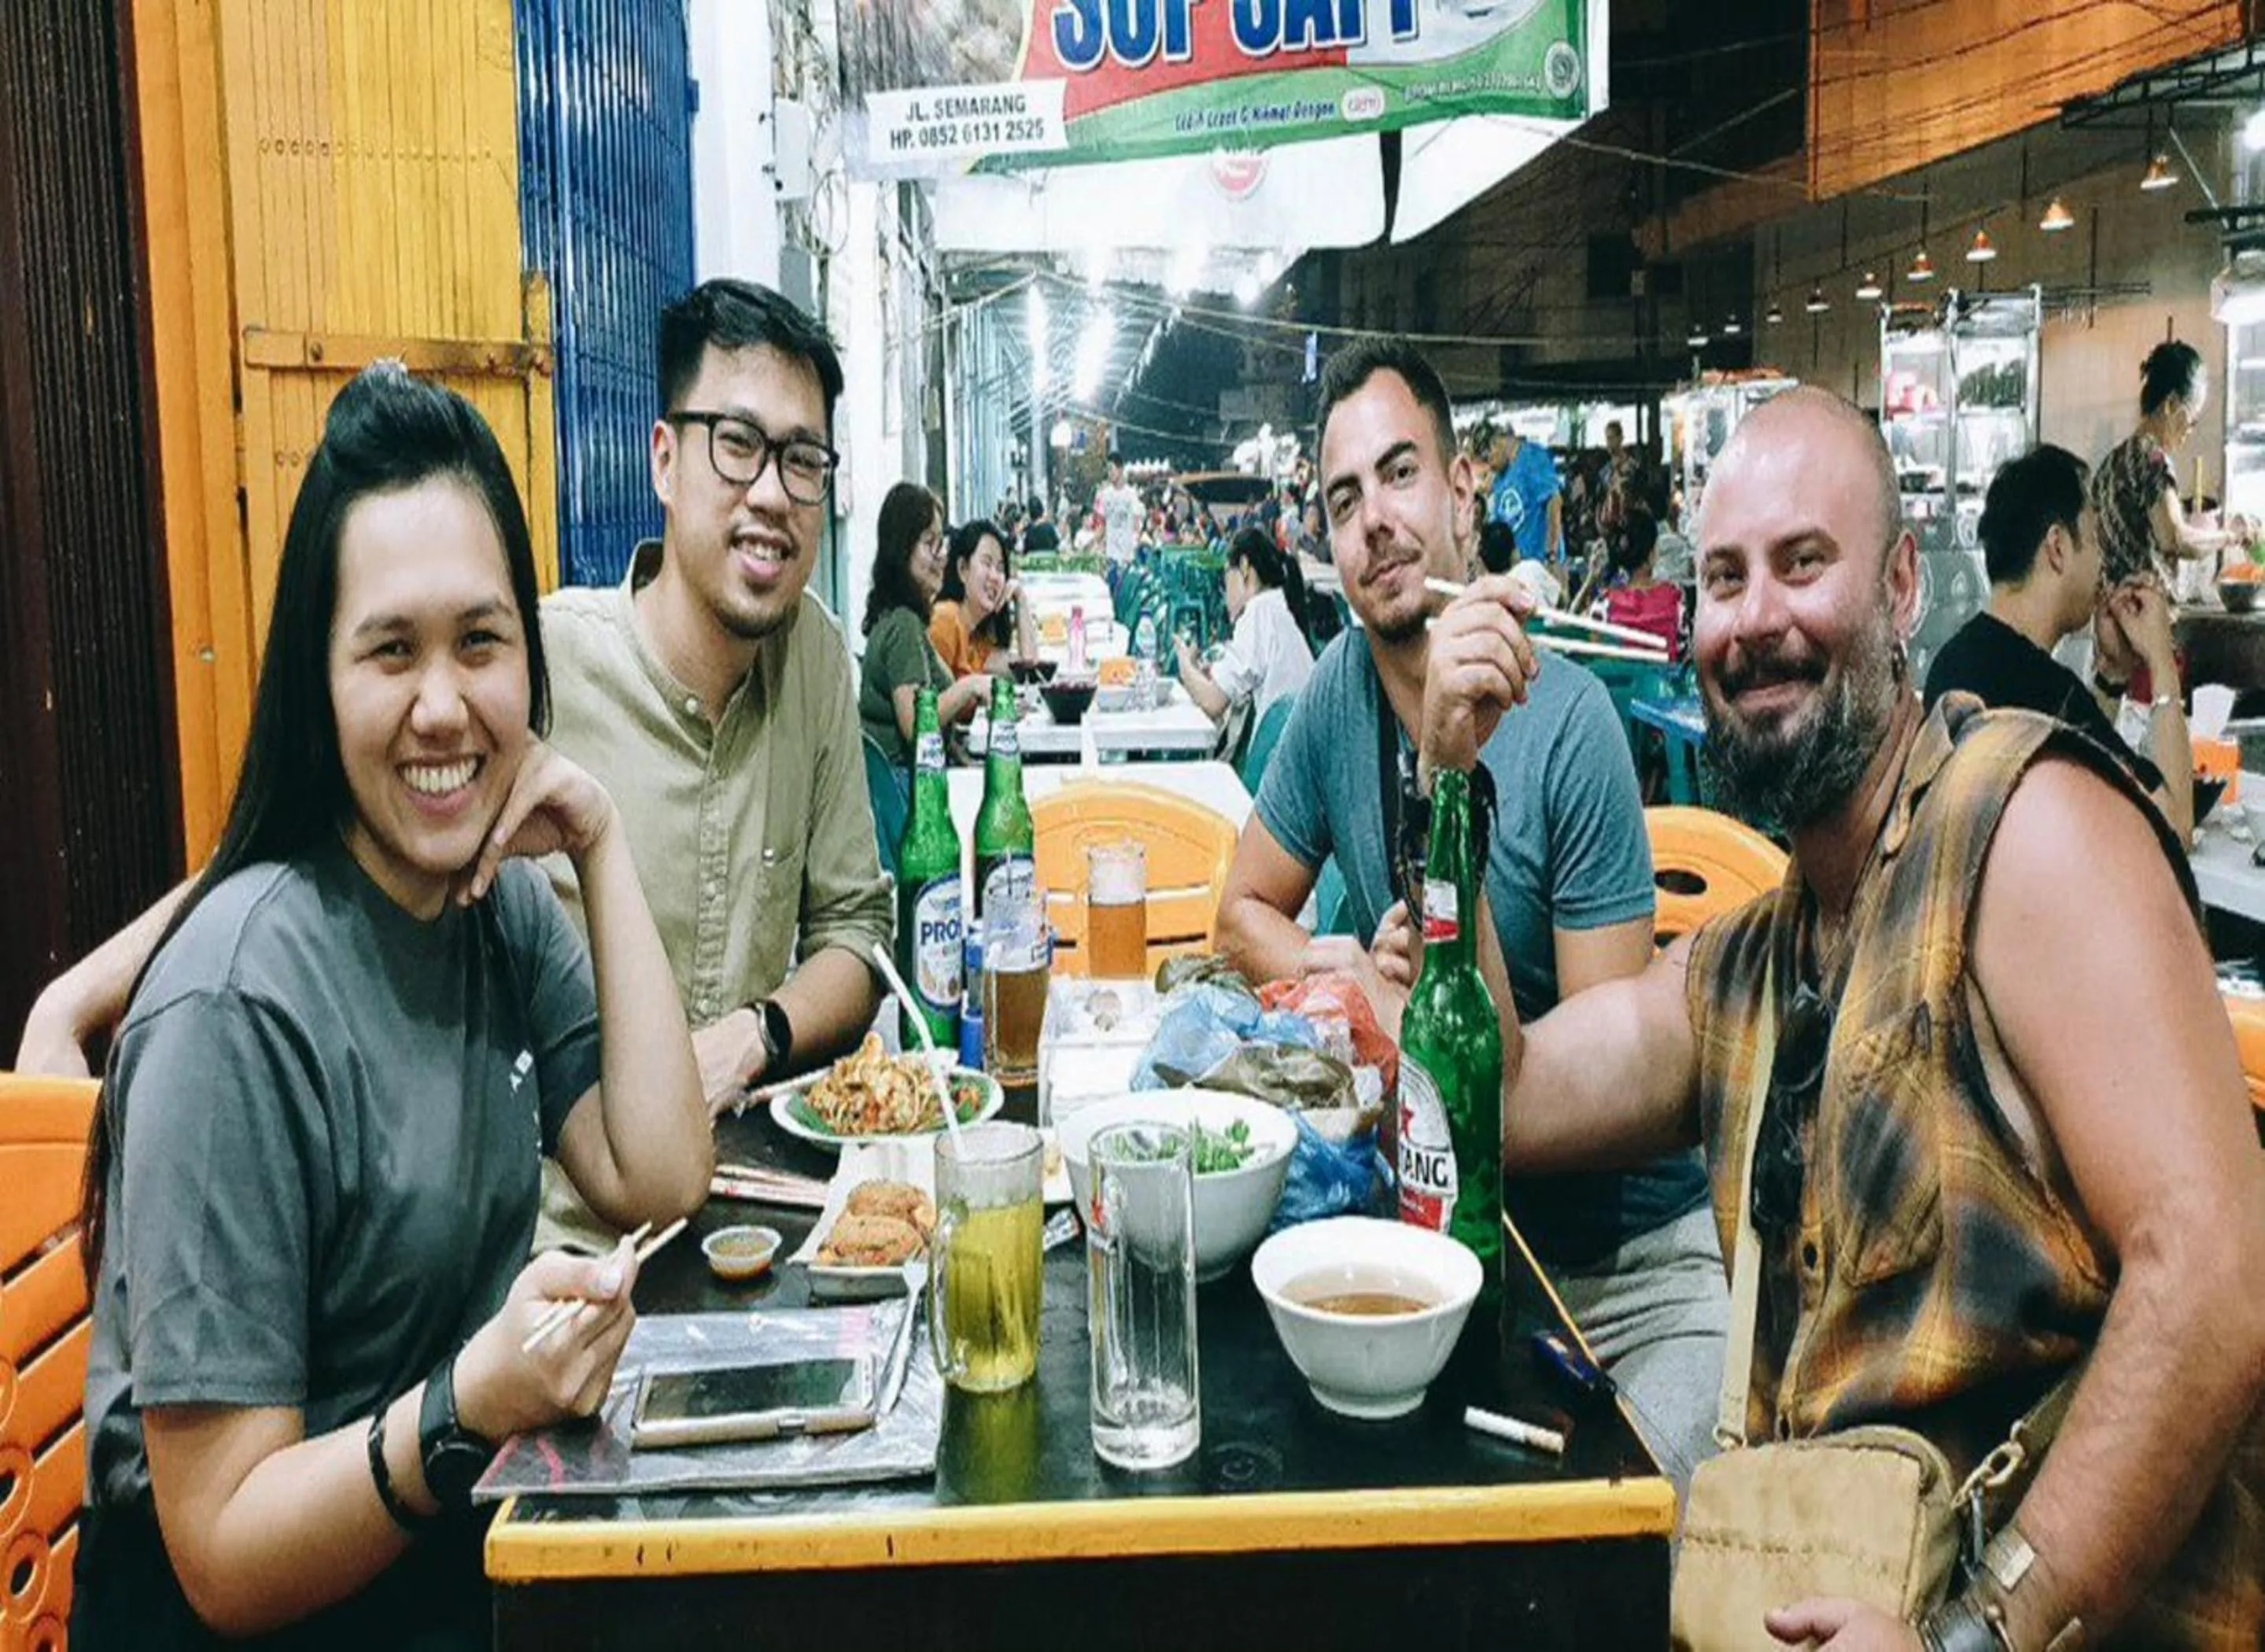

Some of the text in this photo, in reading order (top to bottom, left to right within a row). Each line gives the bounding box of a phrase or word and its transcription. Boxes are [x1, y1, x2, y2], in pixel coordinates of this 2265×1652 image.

[934, 94, 1026, 119] SEMARANG
[890, 129, 915, 149] HP.
[918, 124, 957, 147] 0852
[963, 121, 1000, 143] 6131
